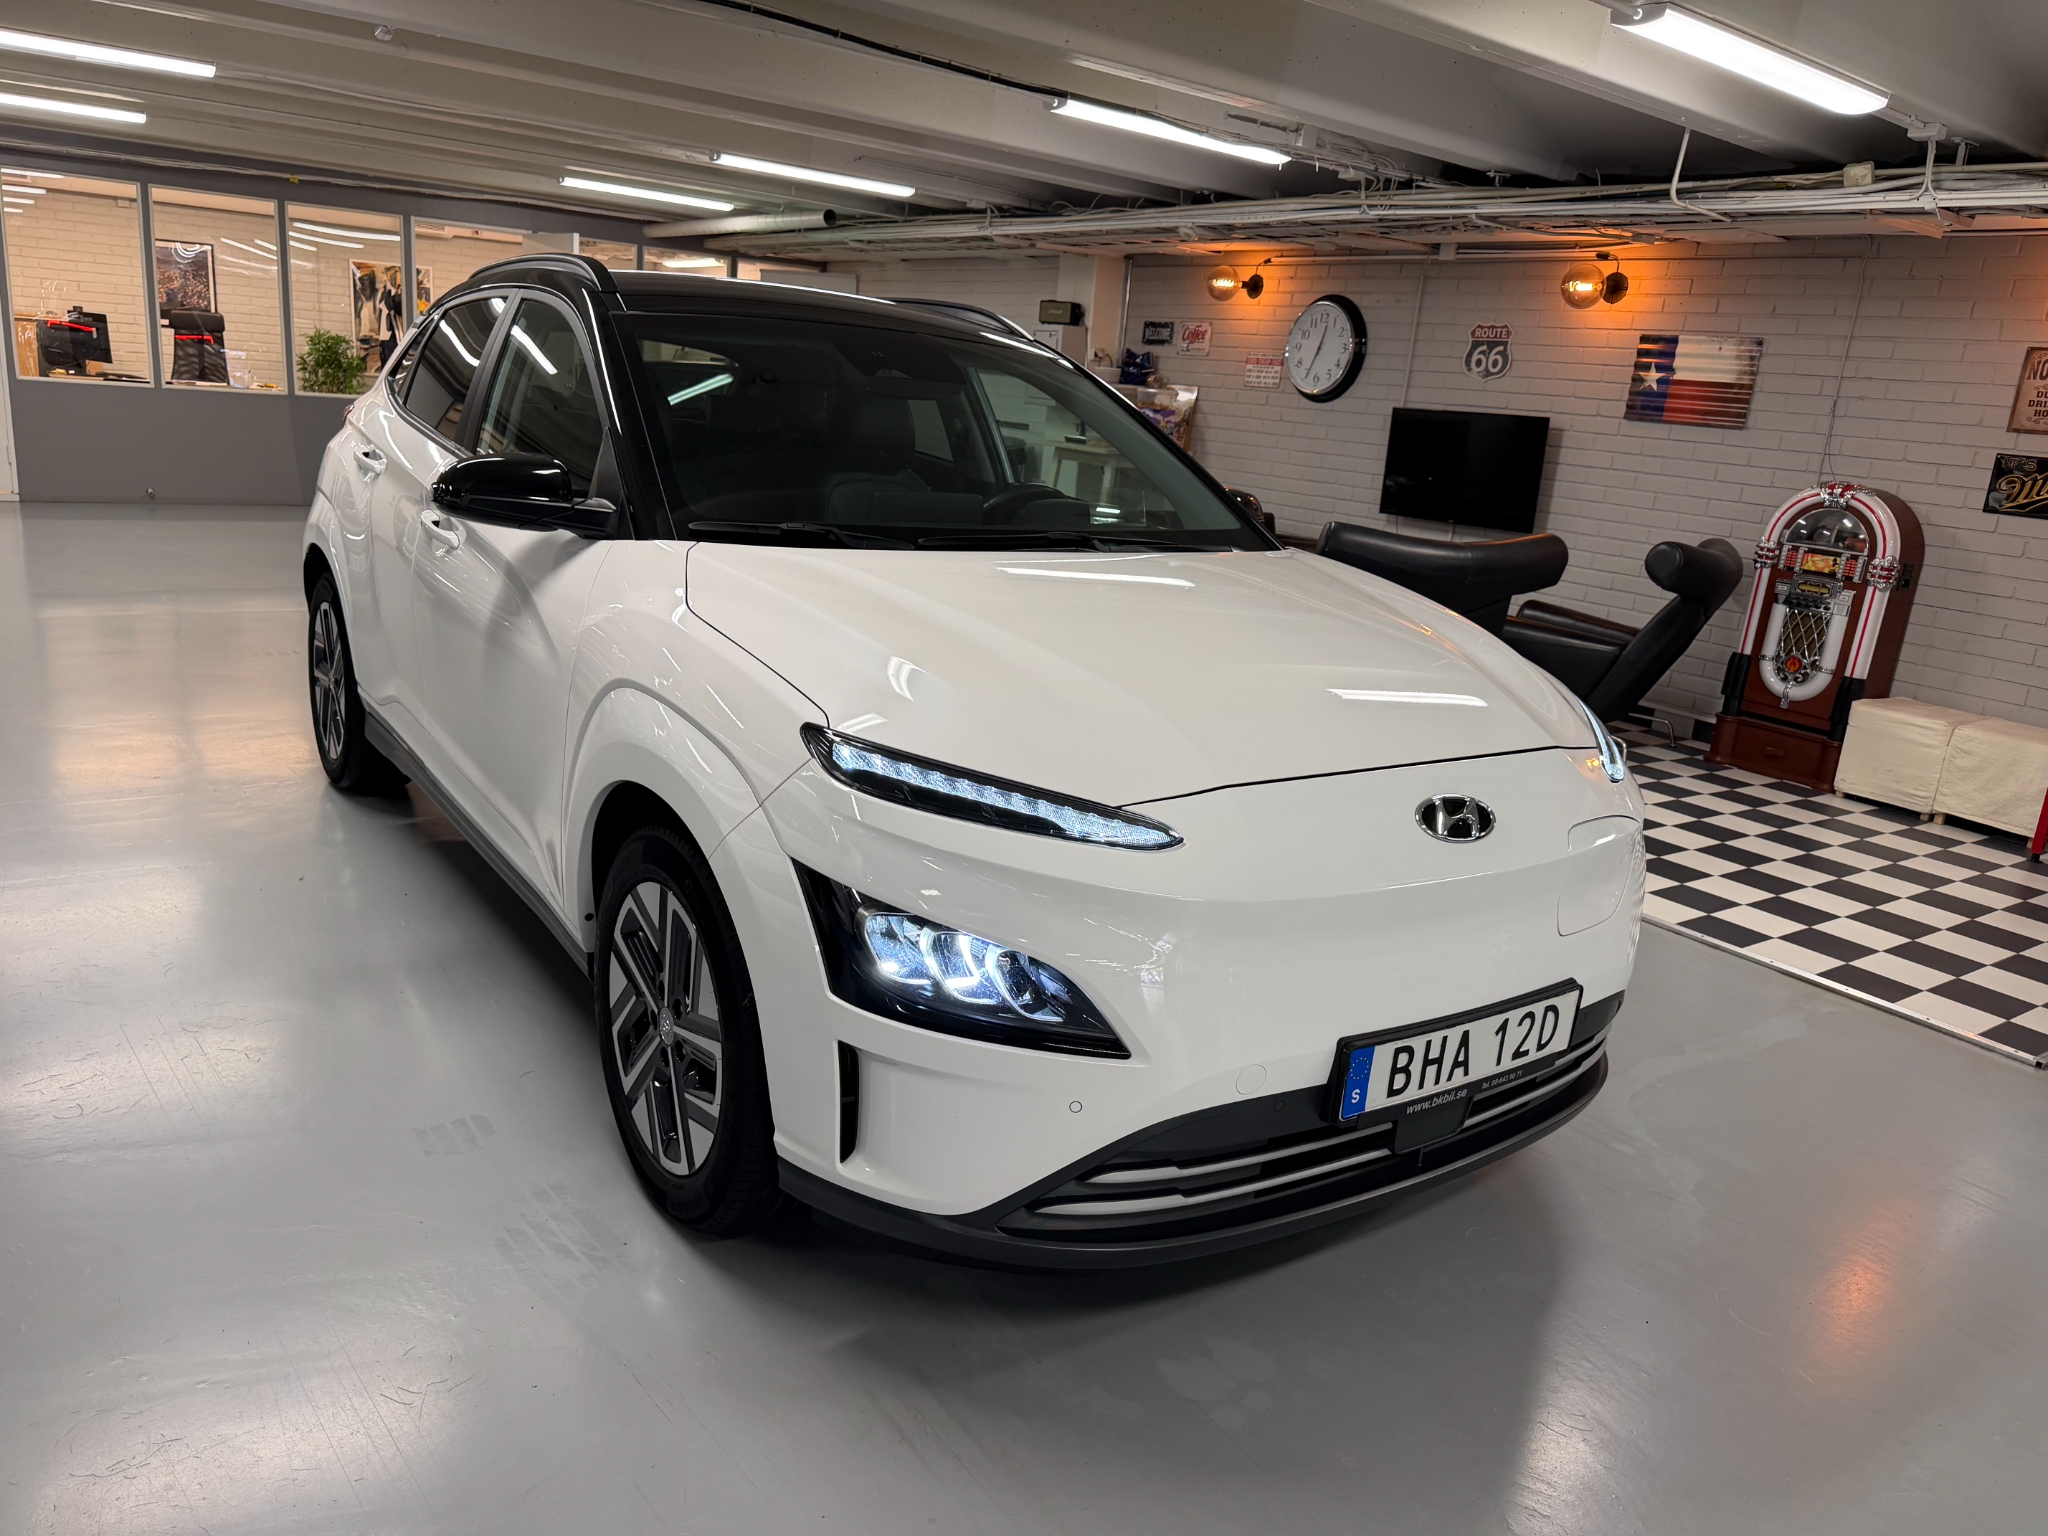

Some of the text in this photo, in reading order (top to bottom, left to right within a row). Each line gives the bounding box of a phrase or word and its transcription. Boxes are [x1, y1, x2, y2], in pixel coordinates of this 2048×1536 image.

[1310, 317, 1318, 328] 11
[1320, 313, 1330, 323] 12
[1182, 325, 1208, 344] Coffee
[1301, 329, 1310, 340] 10
[1338, 326, 1345, 337] 2
[1474, 328, 1509, 338] ROUTE
[1295, 342, 1302, 353] 9
[1341, 343, 1347, 354] 3
[1296, 357, 1303, 368] 8
[1334, 358, 1341, 369] 4
[1471, 345, 1504, 373] 66
[1313, 372, 1320, 384] 6
[1326, 369, 1332, 381] 5
[2027, 399, 2048, 408] DRI
[2001, 457, 2037, 471] IT'S
[1386, 1004, 1560, 1099] BHA 12D
[1351, 1088, 1361, 1104] S
[1406, 1088, 1468, 1115] www.bkbil.se
